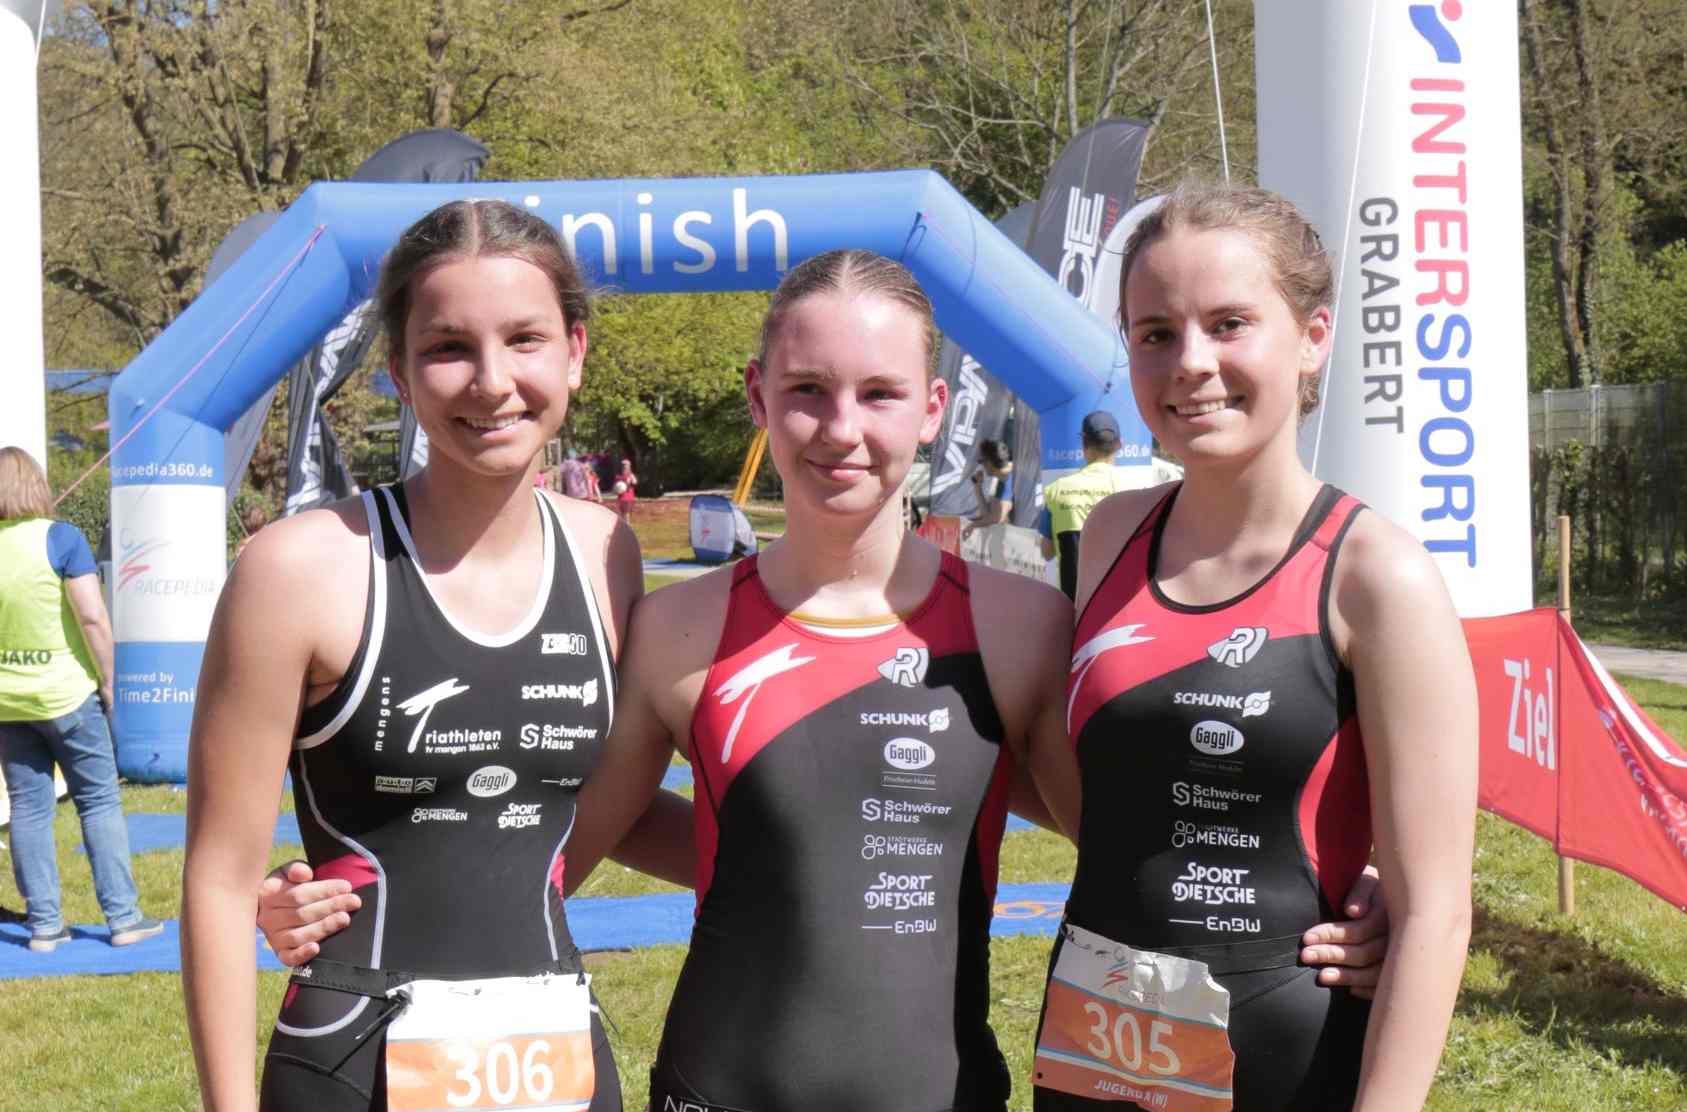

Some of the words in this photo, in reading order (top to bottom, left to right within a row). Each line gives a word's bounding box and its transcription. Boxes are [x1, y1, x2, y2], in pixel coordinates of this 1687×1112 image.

[472, 188, 788, 274] nish
[1360, 197, 1404, 434] GRABERT
[1409, 78, 1476, 568] INTERSPORT
[0, 649, 52, 666] JAKO
[160, 672, 174, 686] by
[119, 687, 195, 704] Time2Fini
[521, 685, 583, 700] SCHUNK
[1174, 692, 1243, 709] SCHUNK
[860, 712, 928, 726] SCHUNK
[1503, 658, 1556, 770] Ziel
[541, 724, 597, 740] Schwörer
[1195, 727, 1235, 750] Gaggli
[541, 737, 575, 750] Haus
[889, 744, 927, 764] Gaggli
[472, 771, 510, 790] Gaggli
[1193, 784, 1262, 803] Schwörer
[502, 803, 542, 816] SPORT
[884, 799, 951, 816] Schwörer
[1193, 797, 1229, 811] Haus
[428, 811, 469, 822] MENGEN
[498, 813, 541, 829] DIETSCHE
[884, 811, 920, 824] Haus
[1196, 831, 1260, 848] MENGEN
[887, 843, 943, 856] MENGEN
[869, 872, 933, 890] SPORT
[1178, 862, 1249, 885] SPORT
[864, 891, 935, 910] DIETSCHE
[1172, 882, 1257, 905] DIETSCHE
[894, 919, 937, 934] EnBW
[1206, 916, 1261, 933] EnBW
[1083, 1000, 1181, 1076] 305
[446, 1039, 555, 1106] 306
